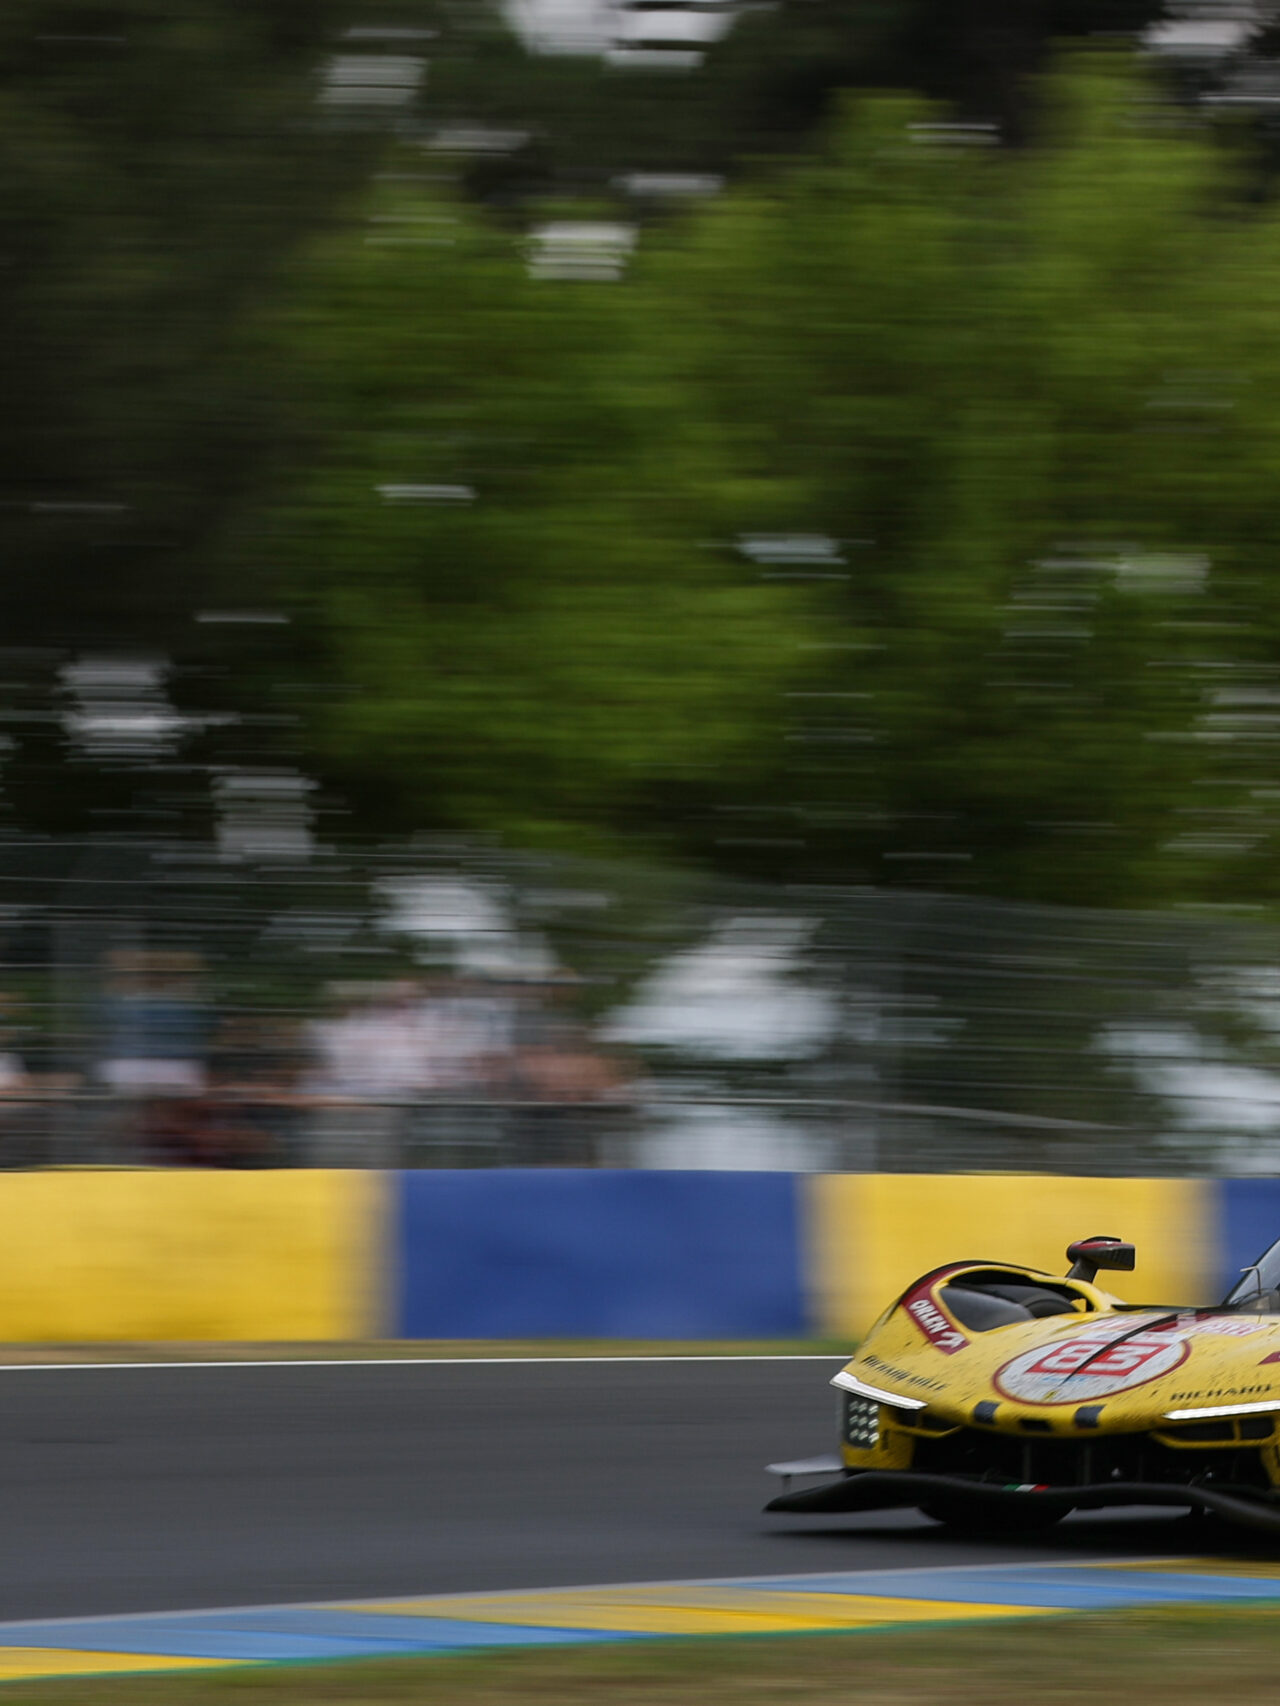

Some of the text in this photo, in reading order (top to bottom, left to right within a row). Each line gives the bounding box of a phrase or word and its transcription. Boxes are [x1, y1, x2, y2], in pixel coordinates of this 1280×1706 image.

[908, 1299, 951, 1334] ORLEN
[1040, 1343, 1160, 1371] 83
[1170, 1382, 1273, 1401] RICHARD
